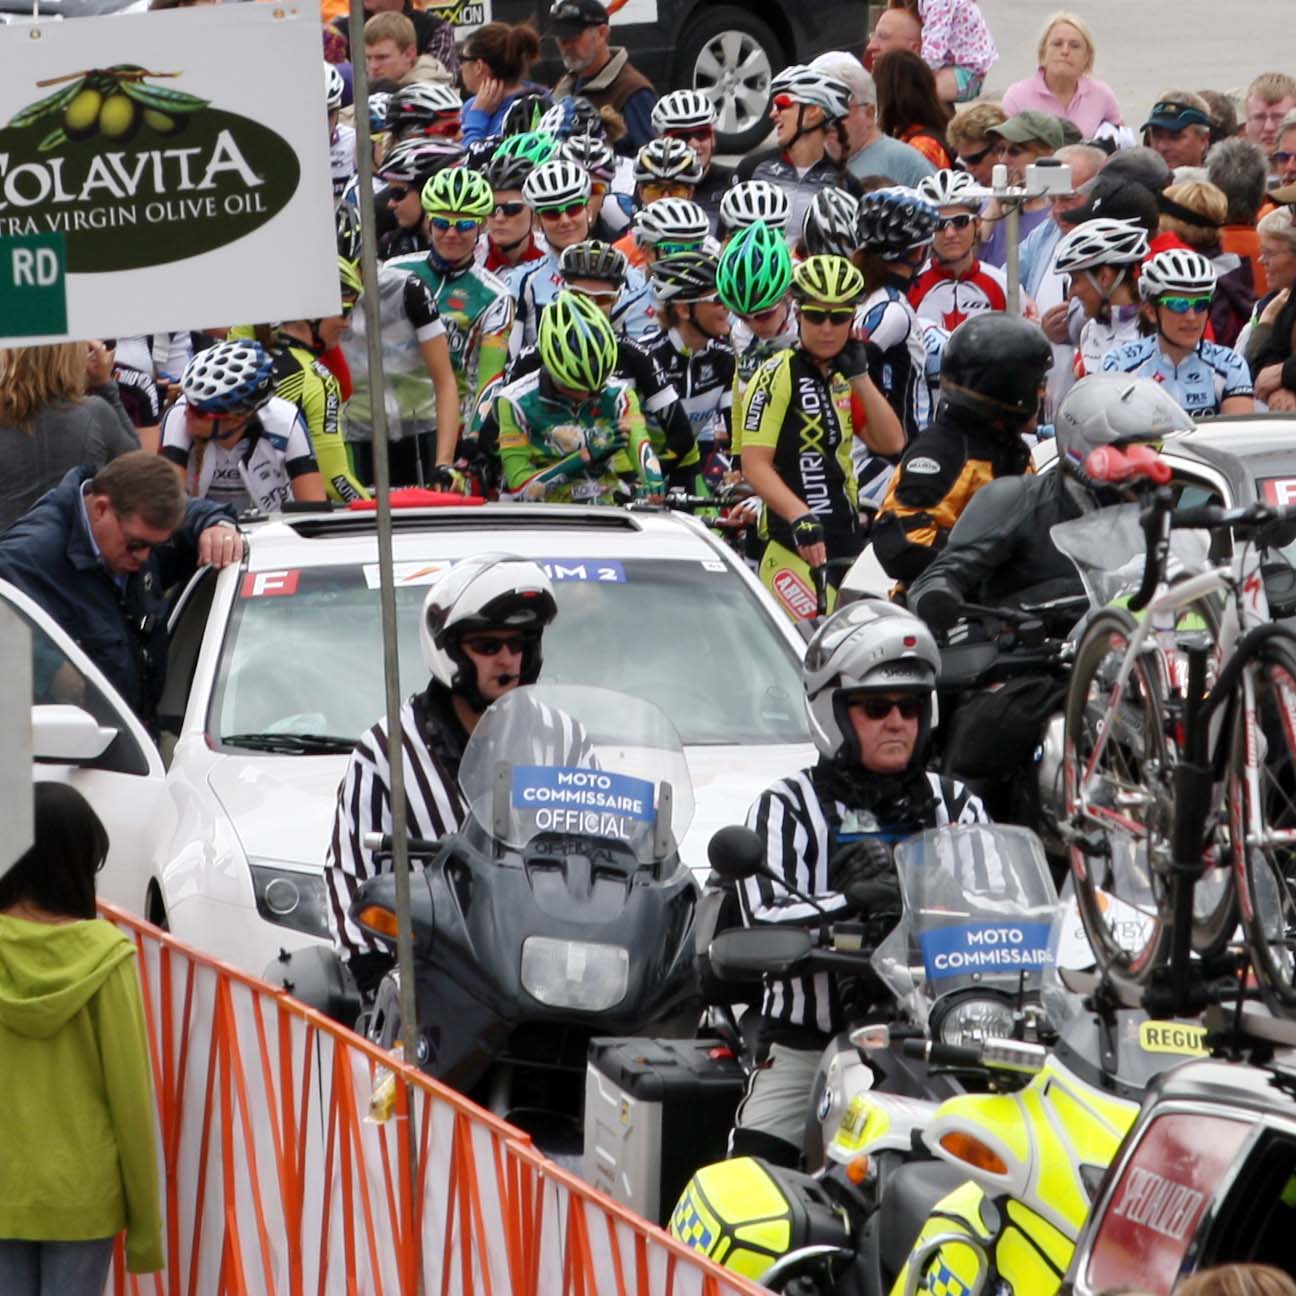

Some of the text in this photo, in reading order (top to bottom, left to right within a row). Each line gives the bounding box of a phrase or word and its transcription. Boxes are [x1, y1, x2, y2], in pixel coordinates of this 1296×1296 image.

[45, 206, 138, 232] VIRGIN
[144, 198, 217, 223] OLIVE
[223, 192, 267, 216] OIL
[12, 245, 61, 289] RD
[252, 570, 289, 596] F
[597, 567, 619, 582] 2
[777, 575, 815, 618] ABUS
[558, 771, 612, 789] MOTO
[522, 787, 643, 814] COMMISSAIRE
[535, 808, 631, 840] OFFICIAL
[966, 928, 1024, 946] MOTO
[934, 948, 1055, 970] COMMISSAIRE
